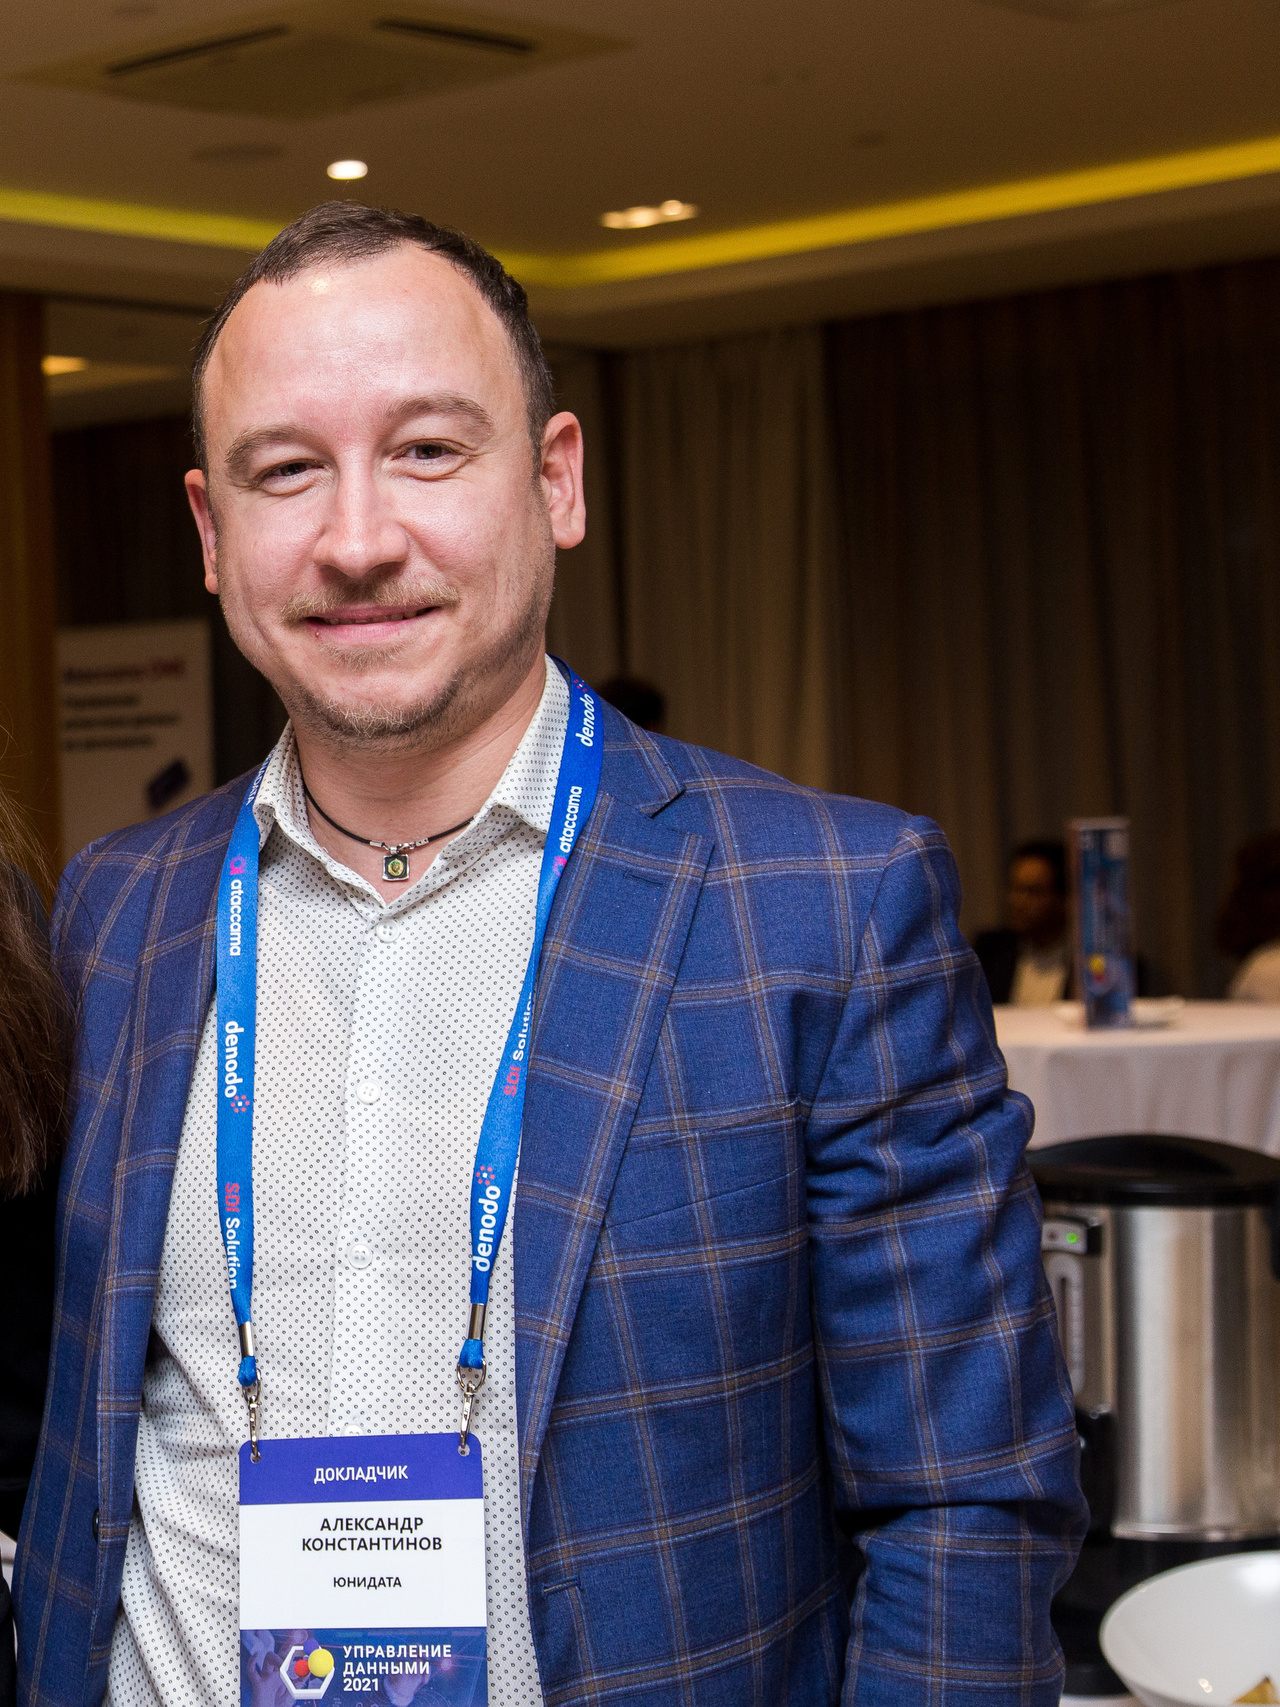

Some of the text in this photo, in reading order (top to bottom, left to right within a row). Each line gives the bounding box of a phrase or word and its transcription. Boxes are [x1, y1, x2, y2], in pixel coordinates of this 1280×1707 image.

[575, 694, 595, 747] denodo
[559, 786, 583, 853] ataccama
[229, 879, 242, 957] ataccama
[224, 1020, 245, 1099] denodo
[504, 1066, 521, 1097] SDI
[225, 1182, 241, 1290] SDI Solution
[472, 1184, 501, 1273] denodo
[313, 1465, 408, 1484] ДОКЛАДЧИК
[320, 1517, 423, 1534] АЛЕКСАНДР
[302, 1537, 442, 1551] КОНСТАНТИНОВ
[333, 1576, 402, 1590] ЮНИДАТА
[342, 1644, 452, 1658] УПРАВЛЕНИЕ
[342, 1661, 430, 1677] ДАННЫМИ
[343, 1678, 380, 1692] 2021
